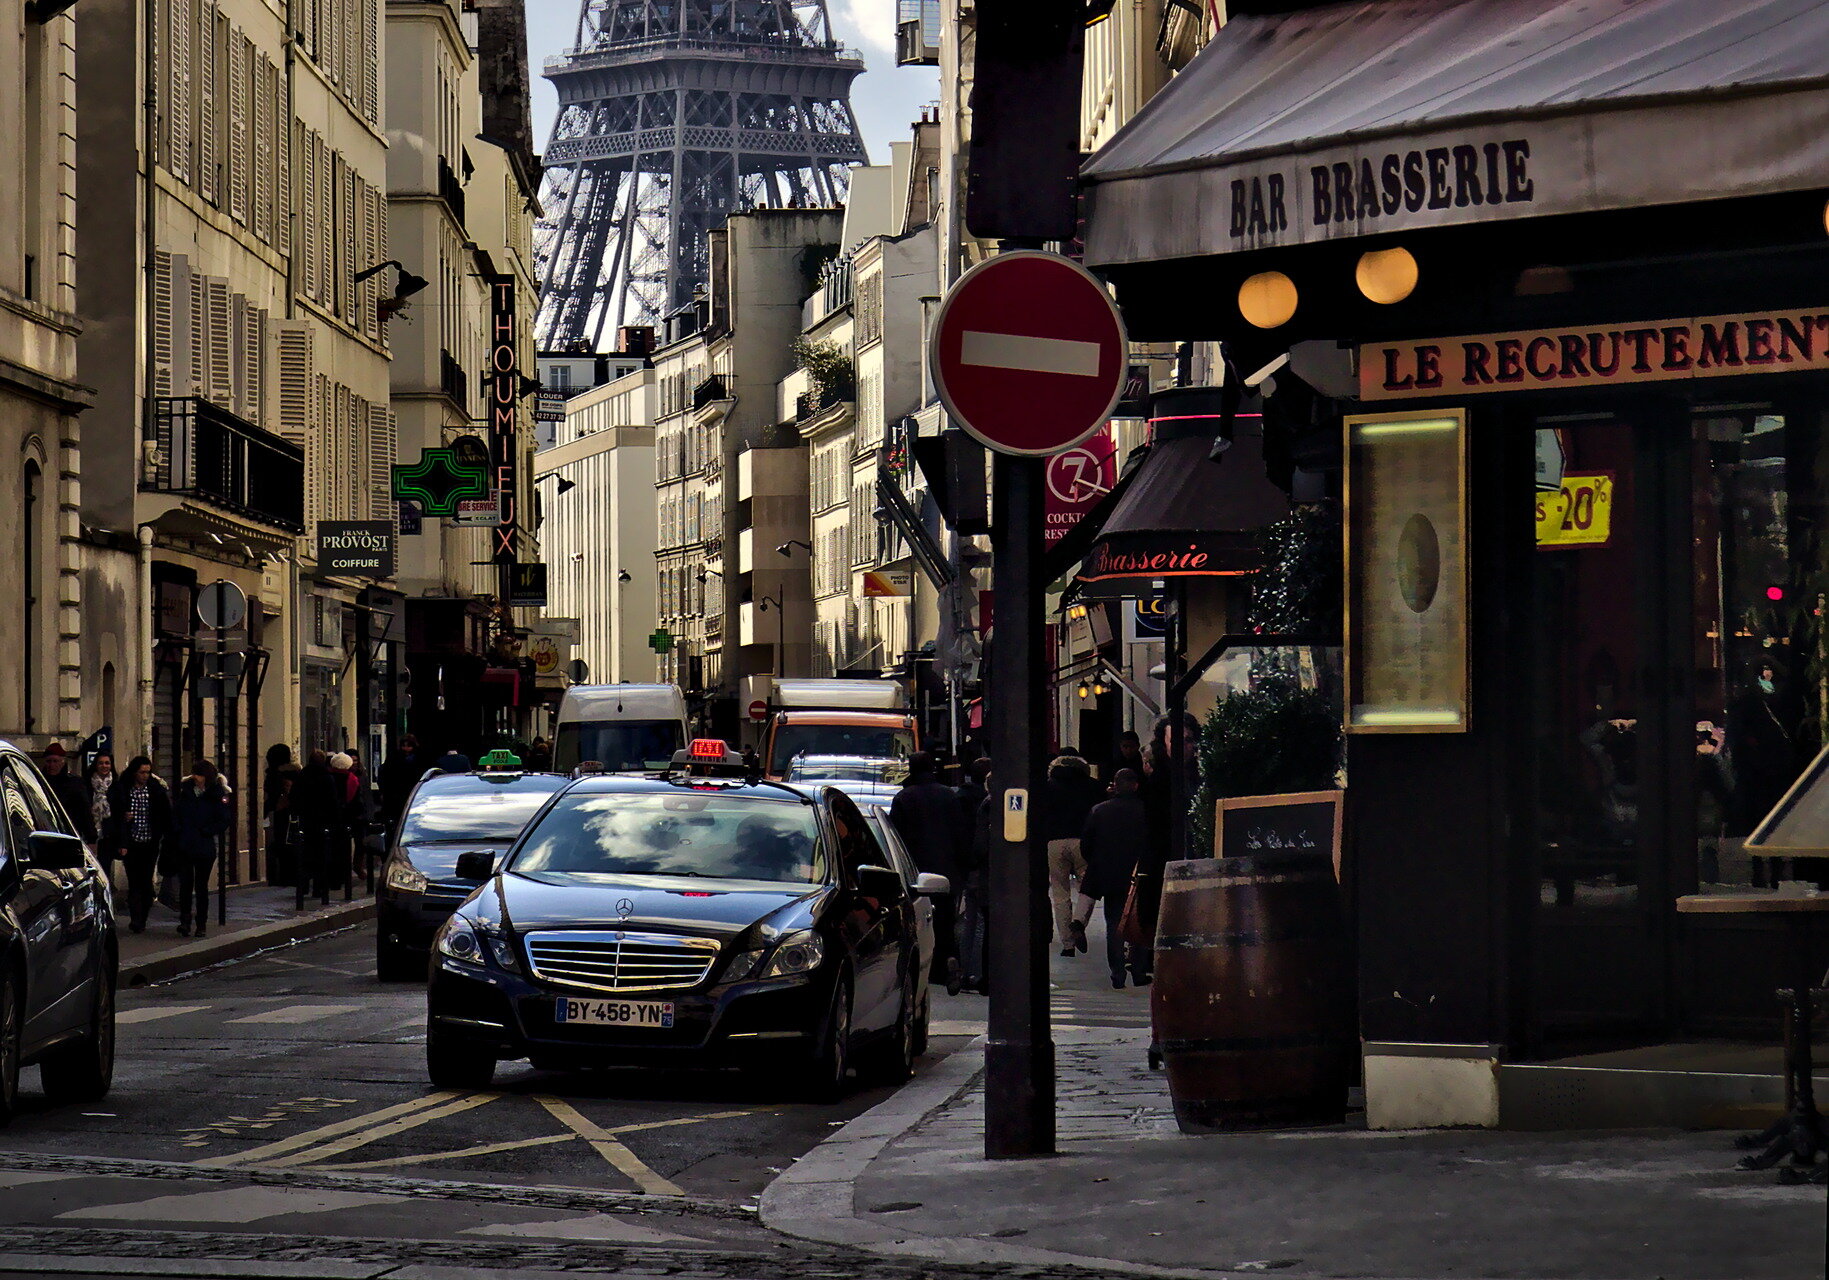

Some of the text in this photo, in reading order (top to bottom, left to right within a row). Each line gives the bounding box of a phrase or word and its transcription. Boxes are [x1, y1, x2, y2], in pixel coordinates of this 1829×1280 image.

[1229, 138, 1535, 238] BAR BRASSERIE
[1382, 344, 1444, 392] LE
[493, 283, 516, 556] THOUMIEUX
[471, 503, 498, 512] SERVICE
[322, 535, 389, 549] PROVOST
[332, 559, 380, 568] COIFFURE
[1097, 541, 1209, 572] Brasserie
[491, 751, 509, 759] TAXI
[693, 741, 721, 755] TAXI
[686, 755, 729, 763] PARISIEN
[567, 1001, 661, 1023] BY-458-YN
